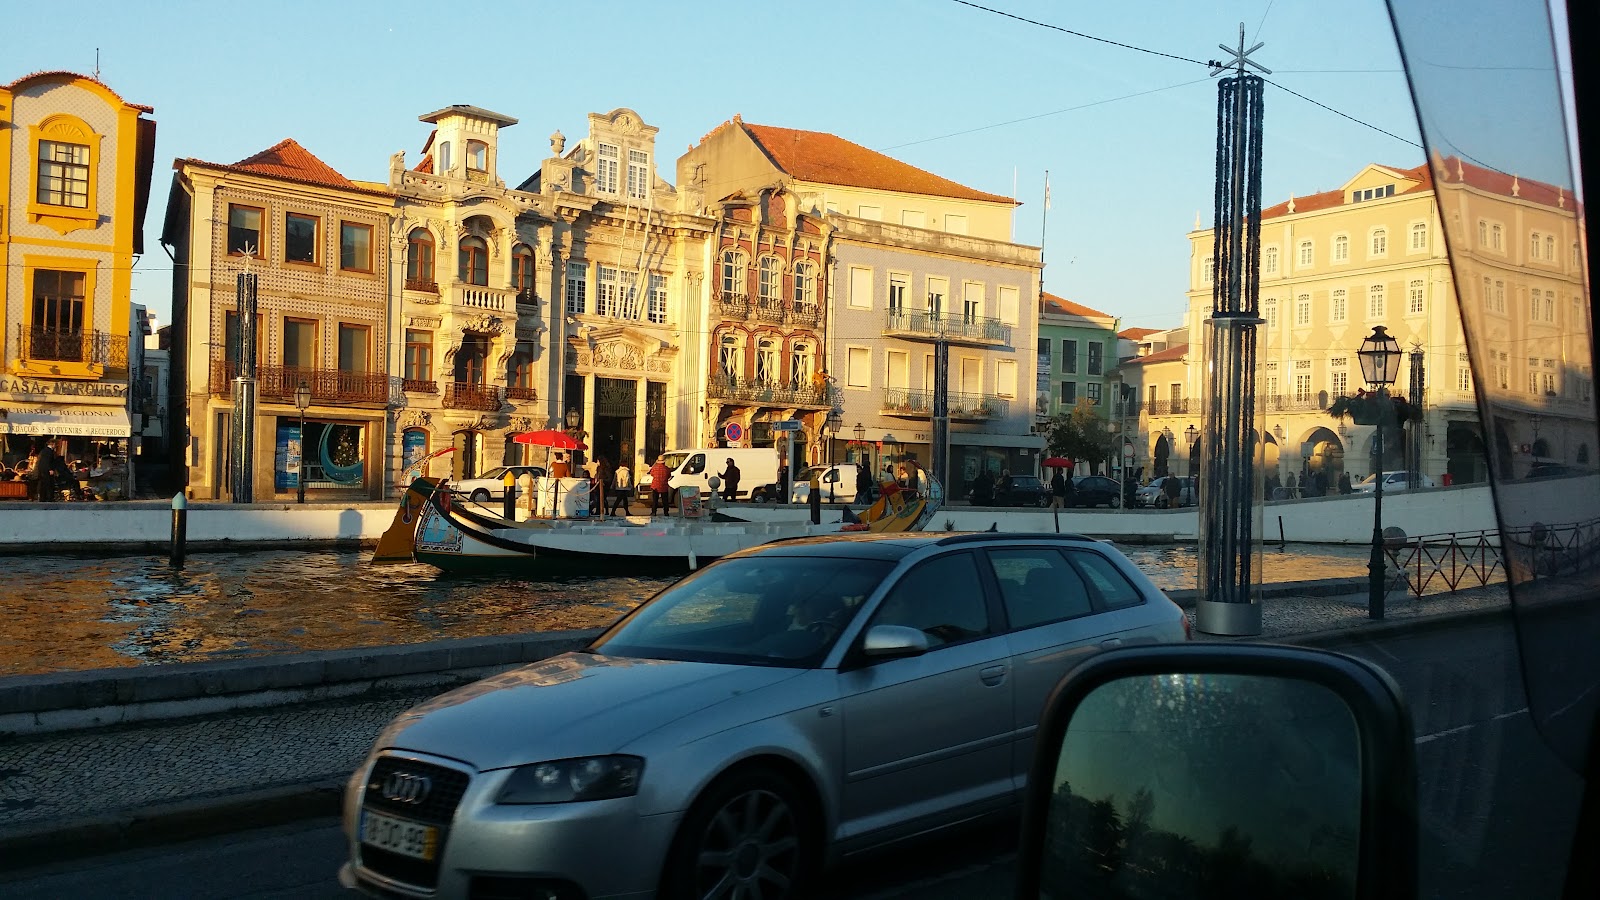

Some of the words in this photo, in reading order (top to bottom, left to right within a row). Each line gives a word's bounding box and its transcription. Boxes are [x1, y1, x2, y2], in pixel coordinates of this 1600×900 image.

[0, 379, 40, 394] CASA
[53, 380, 120, 397] MARQUES
[7, 407, 52, 416] URISMO
[48, 426, 82, 434] SOUVENIRS
[91, 427, 126, 436] RECUERDOS
